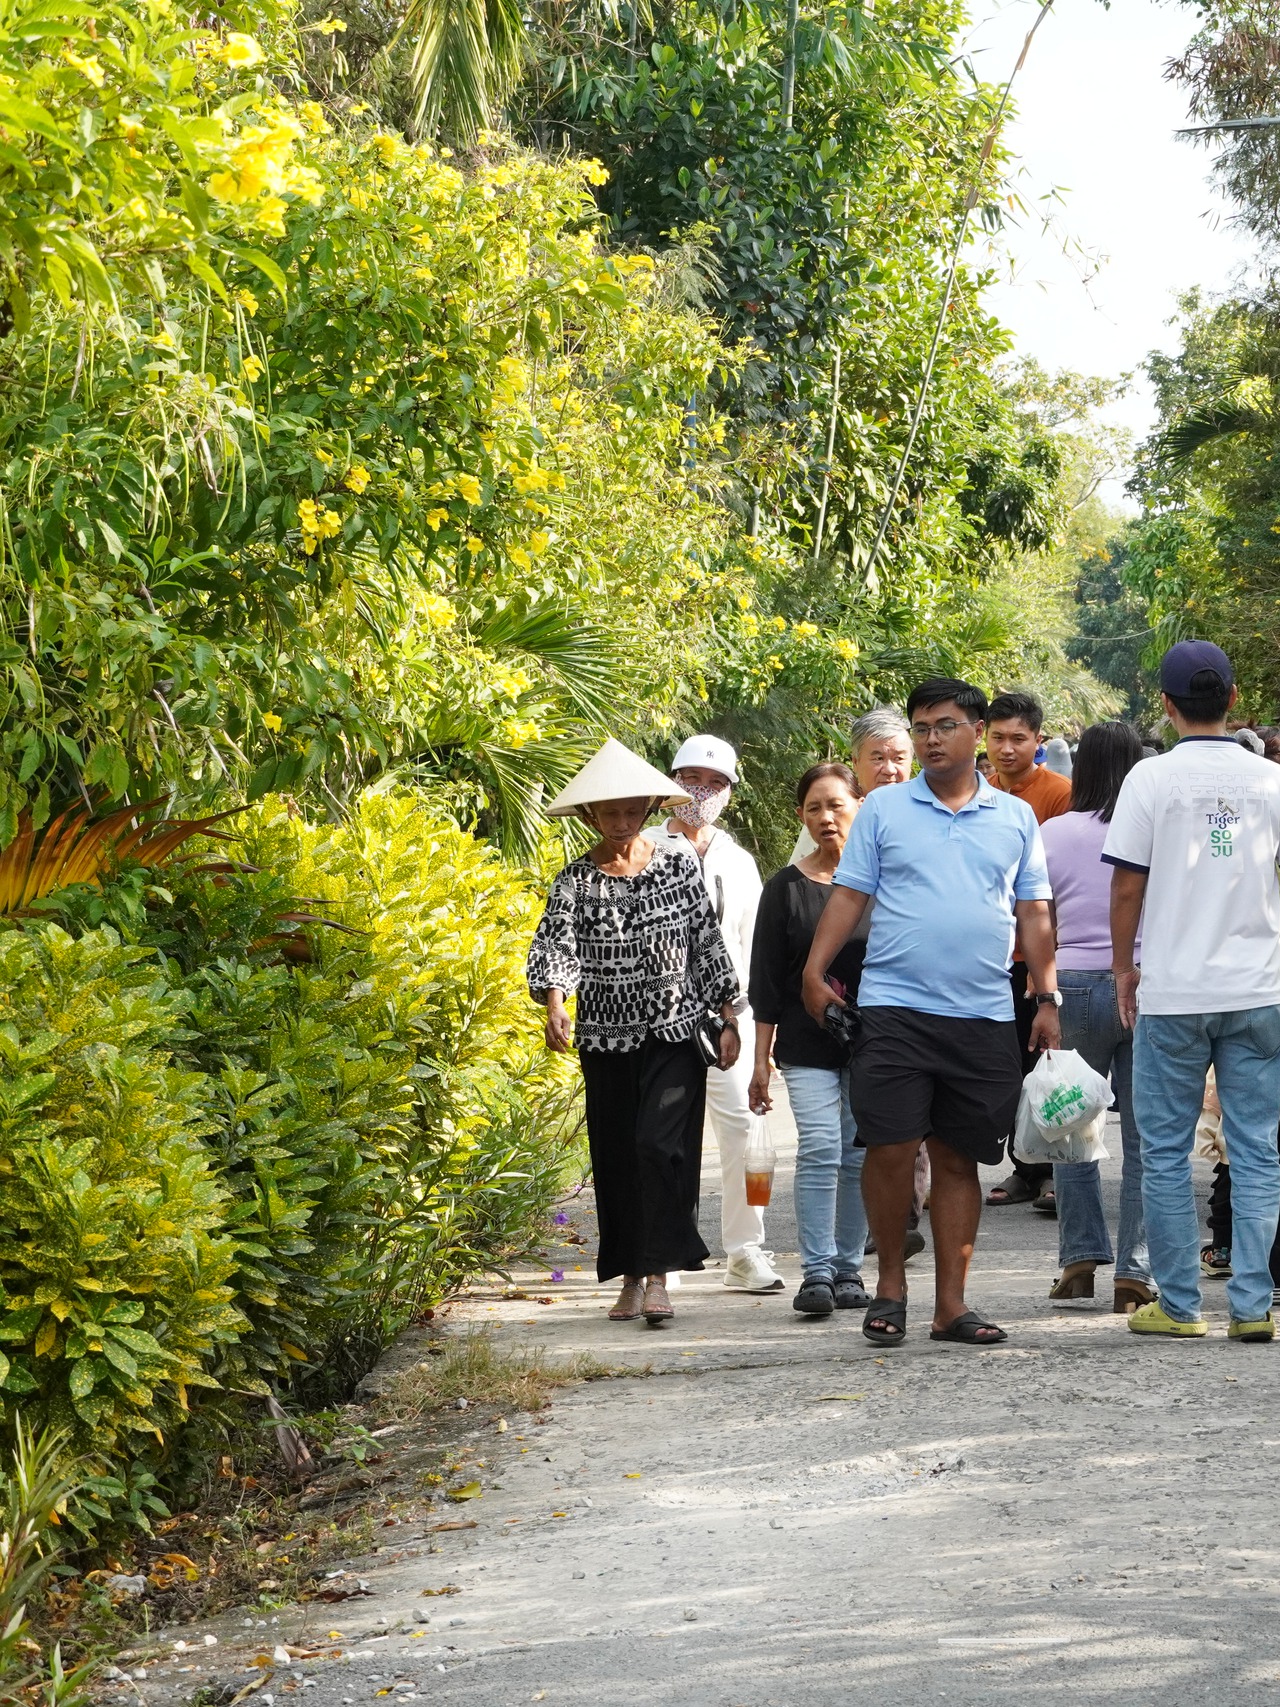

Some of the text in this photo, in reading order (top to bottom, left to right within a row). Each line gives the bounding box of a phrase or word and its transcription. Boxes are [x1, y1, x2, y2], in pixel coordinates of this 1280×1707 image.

[1206, 812, 1240, 829] Tiger
[1211, 830, 1232, 844] SO
[1211, 845, 1233, 857] JU
